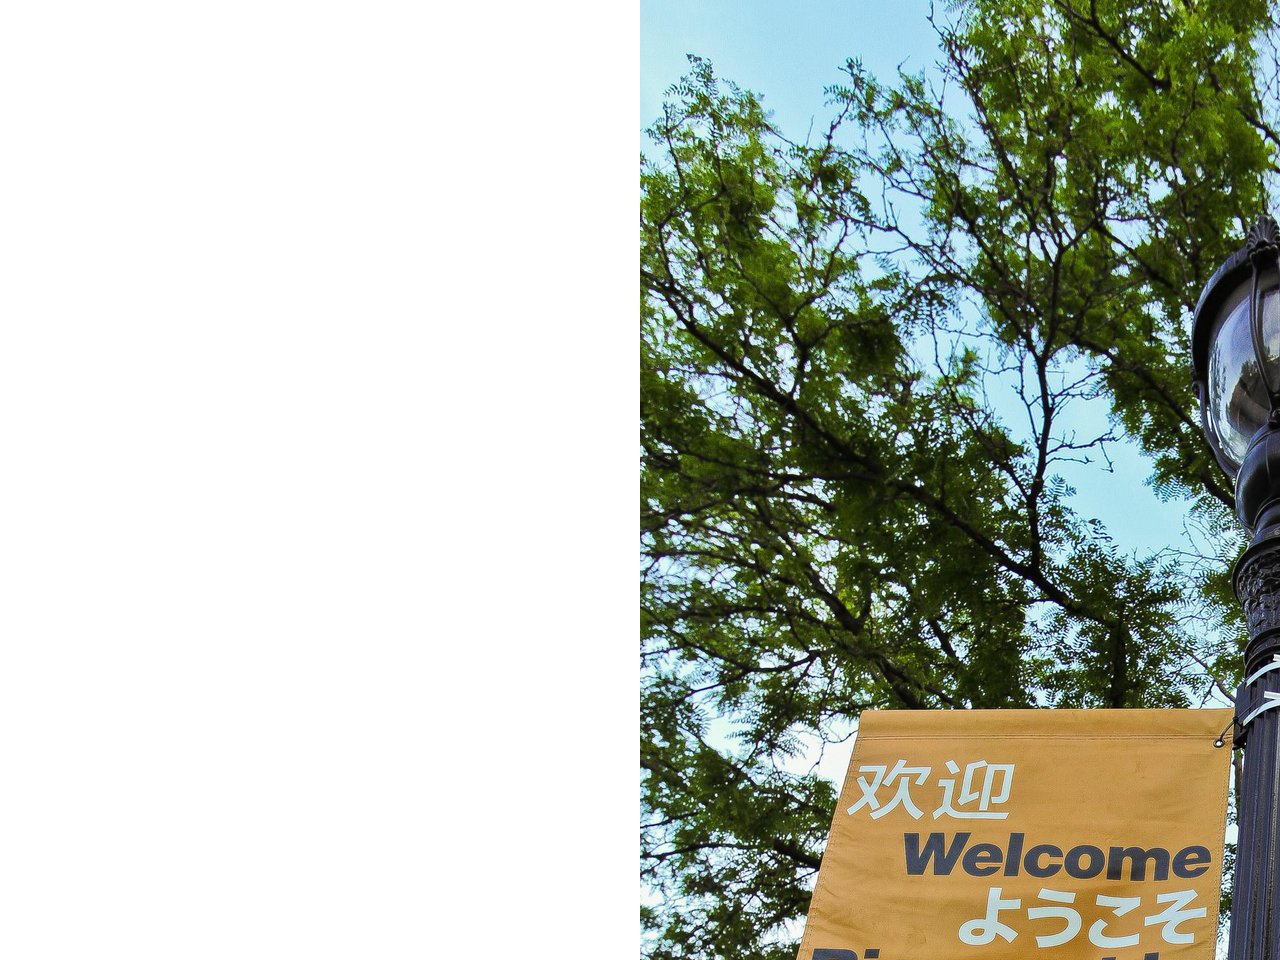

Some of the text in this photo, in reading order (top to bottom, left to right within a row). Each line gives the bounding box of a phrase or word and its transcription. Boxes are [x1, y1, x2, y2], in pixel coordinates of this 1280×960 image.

[846, 758, 1015, 821] 欢迎
[903, 832, 1212, 882] Welcome
[958, 887, 1207, 949] ようこそ
